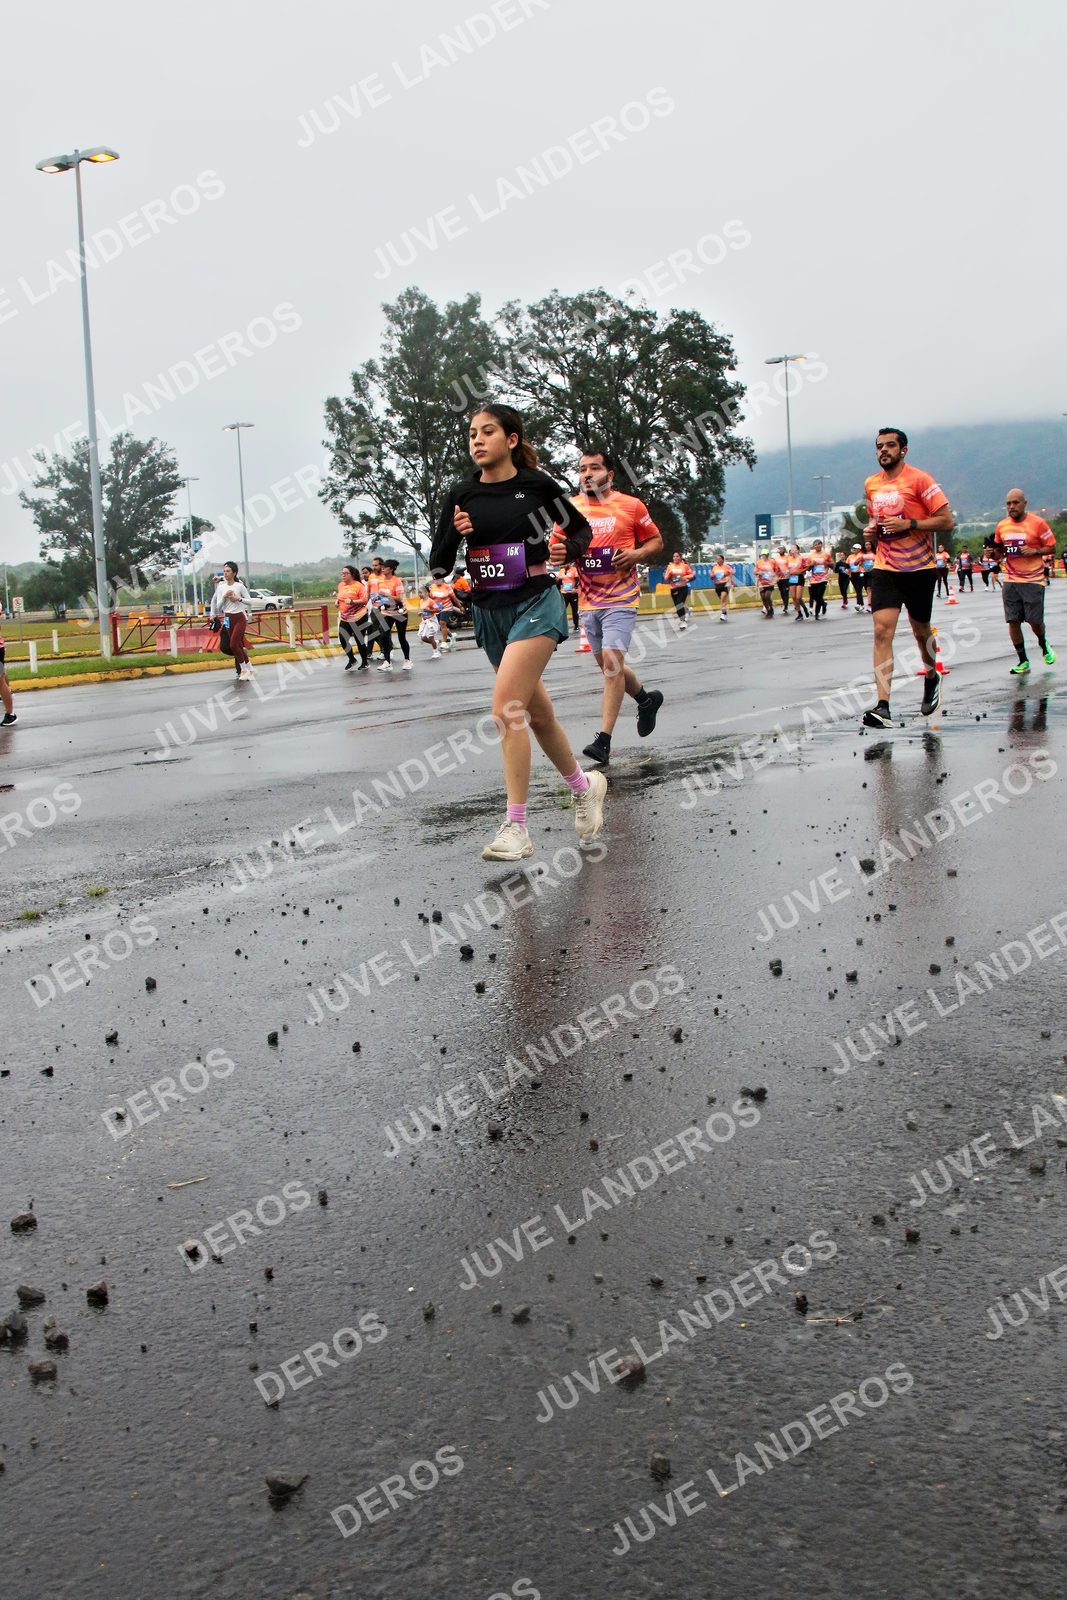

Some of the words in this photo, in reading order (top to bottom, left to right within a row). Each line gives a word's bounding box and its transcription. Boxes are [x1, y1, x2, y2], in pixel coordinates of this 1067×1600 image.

[758, 524, 768, 537] E
[585, 559, 602, 568] 692
[479, 563, 505, 578] 502
